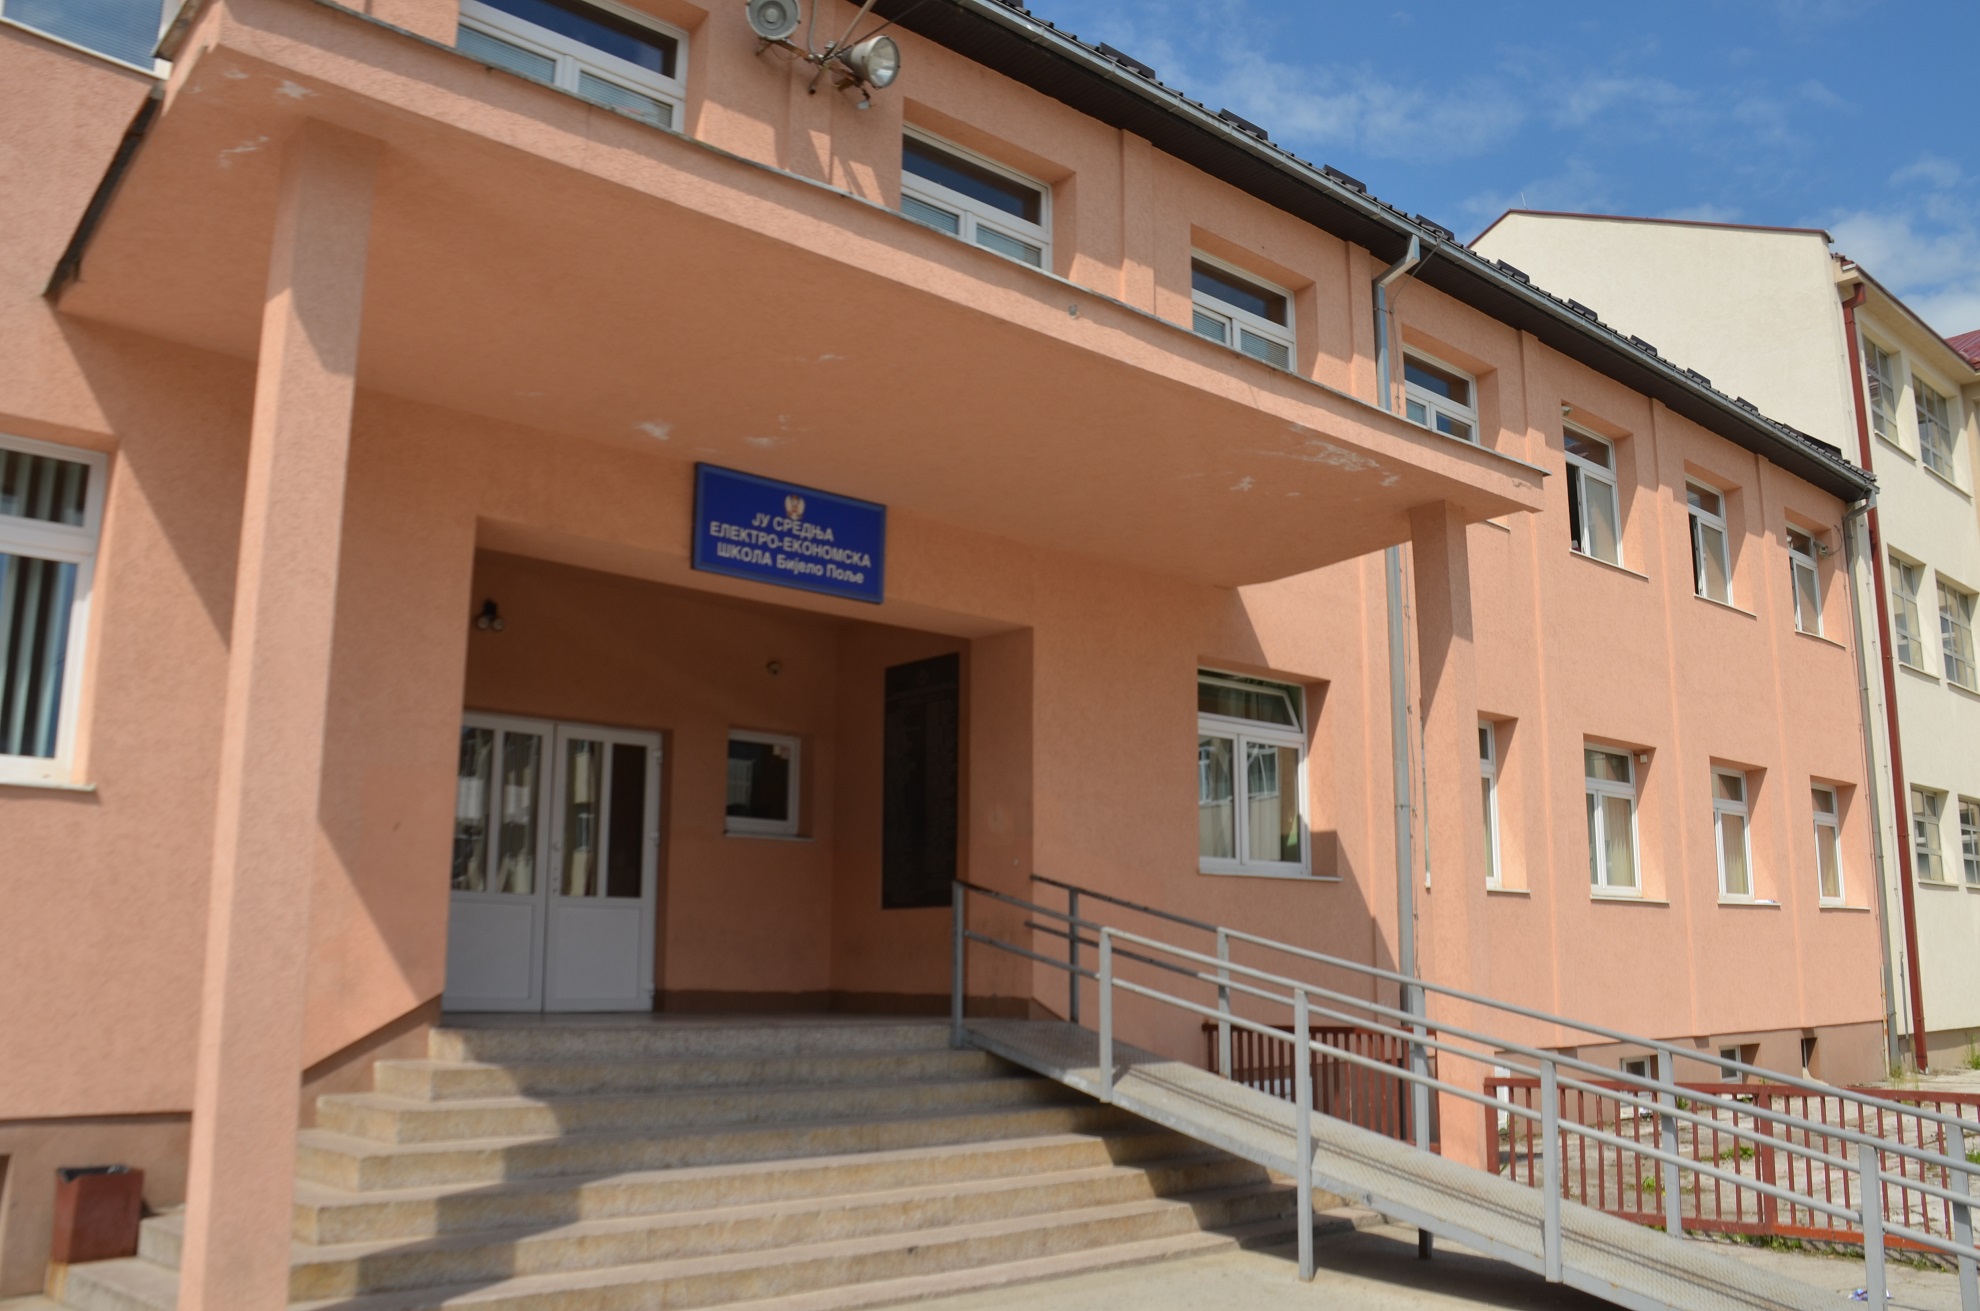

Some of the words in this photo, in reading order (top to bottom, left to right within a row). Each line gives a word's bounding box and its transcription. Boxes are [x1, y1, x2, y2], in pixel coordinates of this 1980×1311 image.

[710, 521, 871, 568] ЕЛЕКТРО-ЕКОНОМСКА
[772, 516, 833, 542] СРЕДЊА
[717, 541, 772, 566] ШКОЛА
[776, 554, 823, 575] Бијело
[826, 566, 864, 583] Поље
